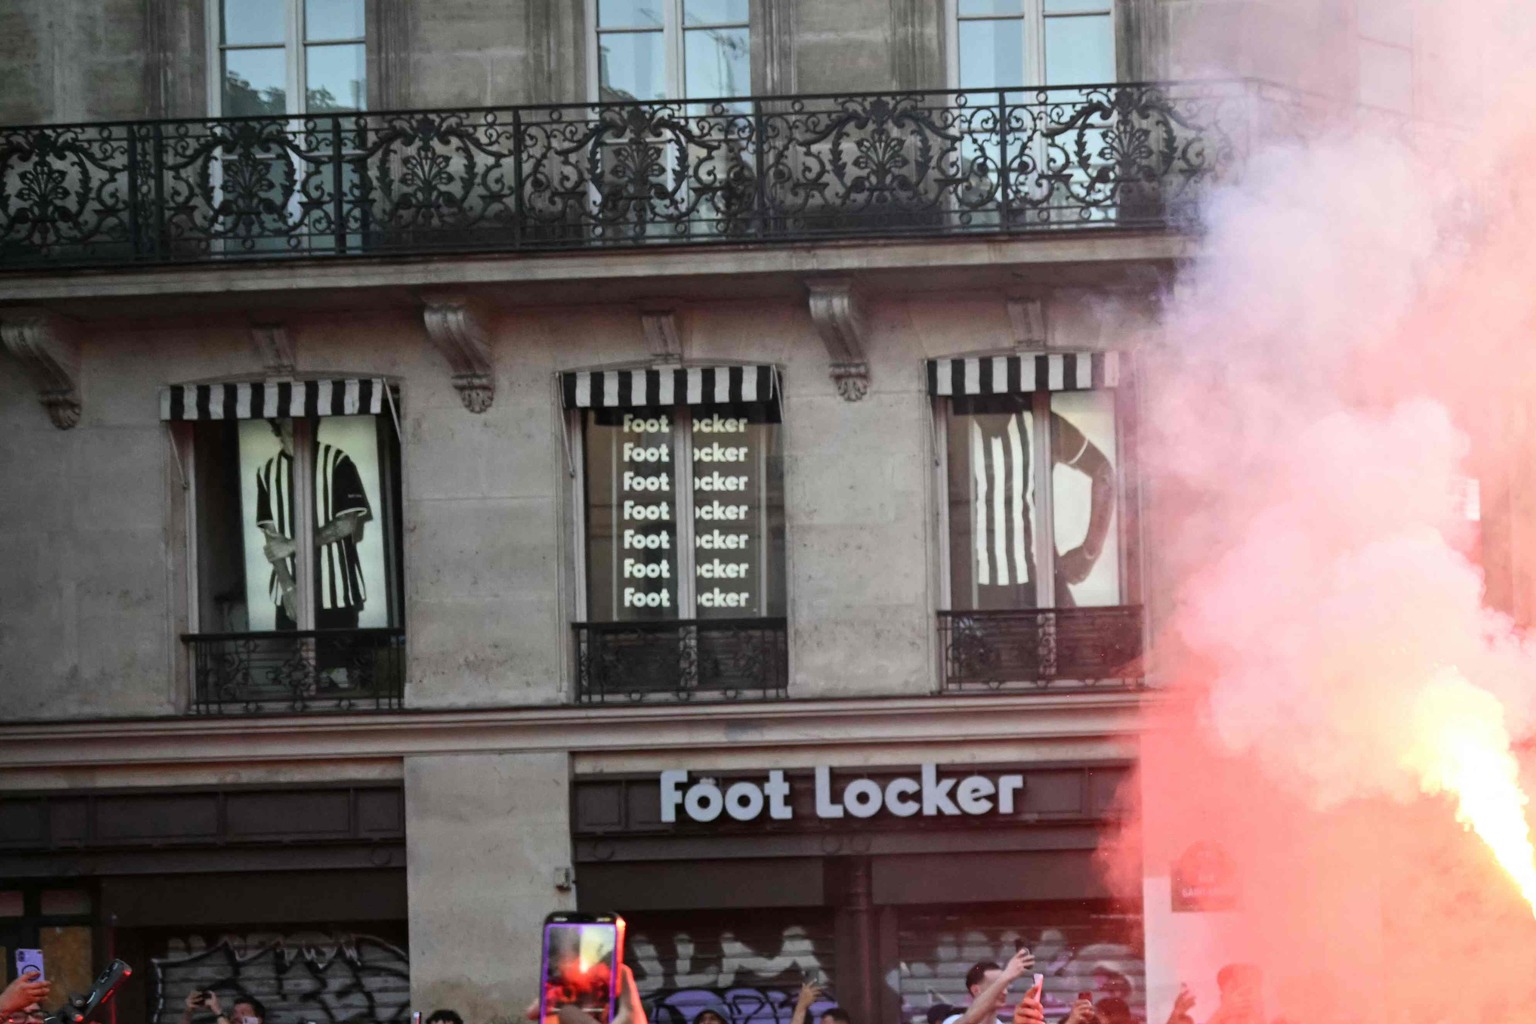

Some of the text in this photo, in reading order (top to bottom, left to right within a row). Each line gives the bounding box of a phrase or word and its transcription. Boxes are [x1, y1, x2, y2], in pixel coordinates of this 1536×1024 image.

[623, 413, 749, 433] Foot ocker
[623, 442, 670, 462] Foot
[623, 471, 670, 491] Foot
[623, 500, 670, 520] Foot
[624, 529, 670, 549] Foot
[624, 558, 671, 578] Foot
[624, 587, 671, 608] Foot
[660, 763, 1024, 823] Foot Locker
